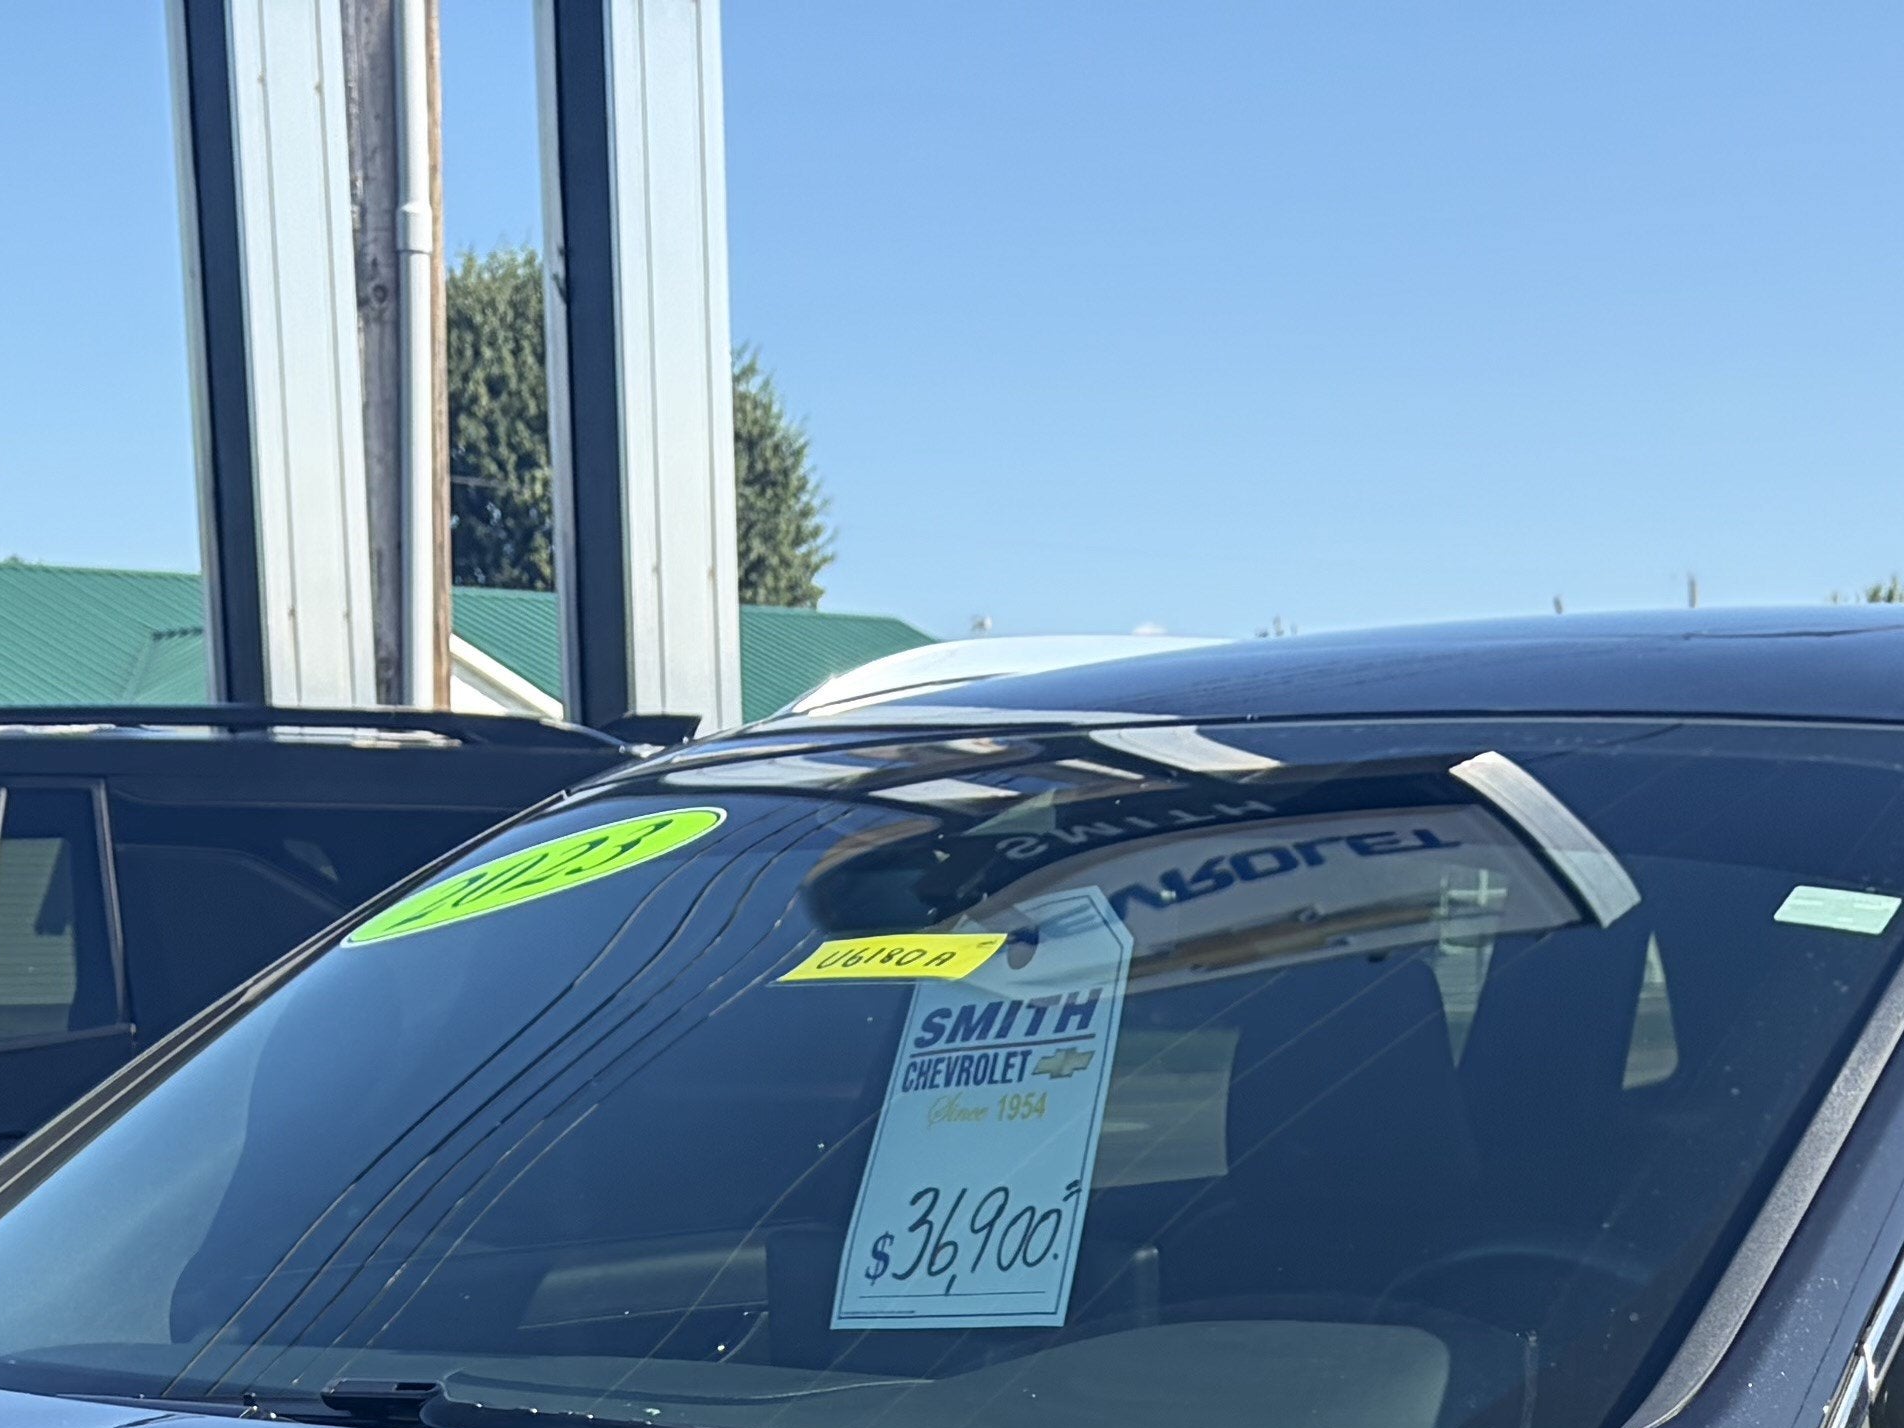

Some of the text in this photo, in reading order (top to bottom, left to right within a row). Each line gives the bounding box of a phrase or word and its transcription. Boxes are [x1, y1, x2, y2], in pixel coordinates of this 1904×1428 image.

[381, 818, 676, 932] 2023
[913, 987, 1104, 1049] SMITH
[900, 1050, 1034, 1094] CHEVROLET
[927, 1092, 1048, 1129] Since 1954
